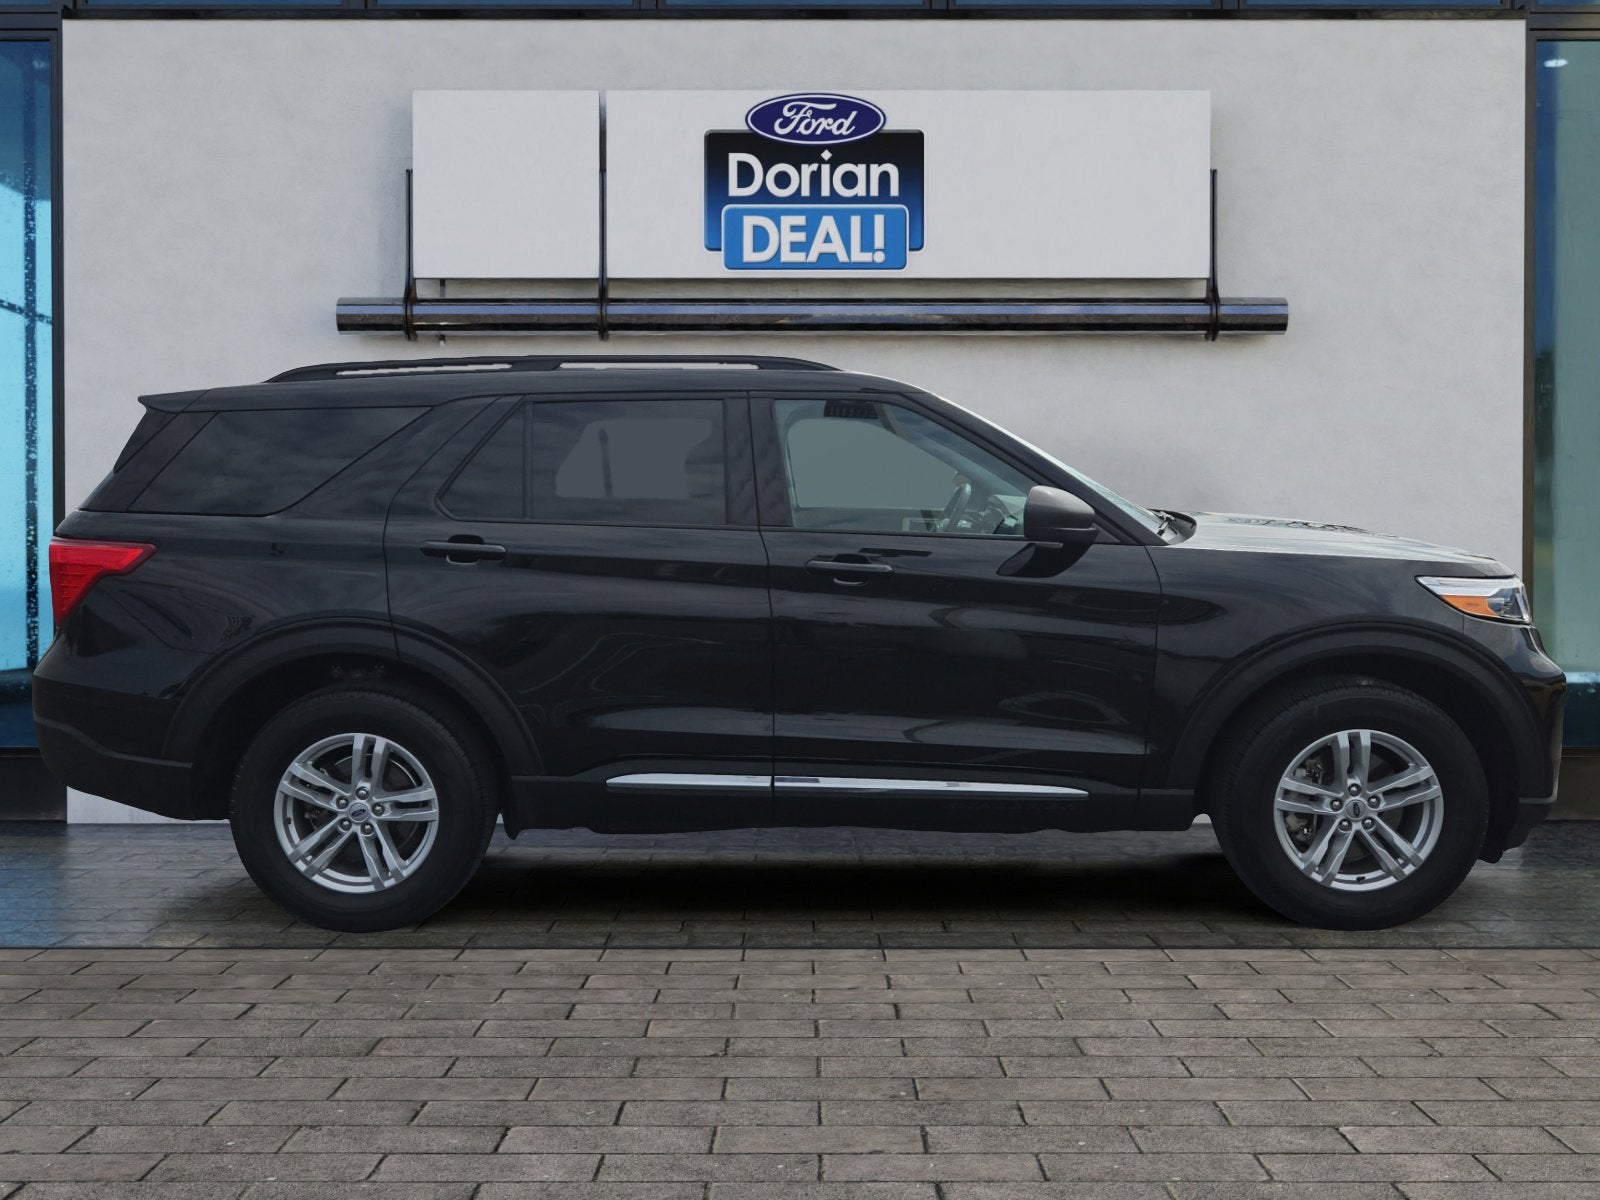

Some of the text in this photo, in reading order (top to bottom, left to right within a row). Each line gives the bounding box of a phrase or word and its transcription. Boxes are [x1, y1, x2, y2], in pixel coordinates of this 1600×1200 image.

[774, 101, 858, 136] Ford
[728, 149, 899, 197] Dorian
[743, 214, 886, 263] DEAL!
